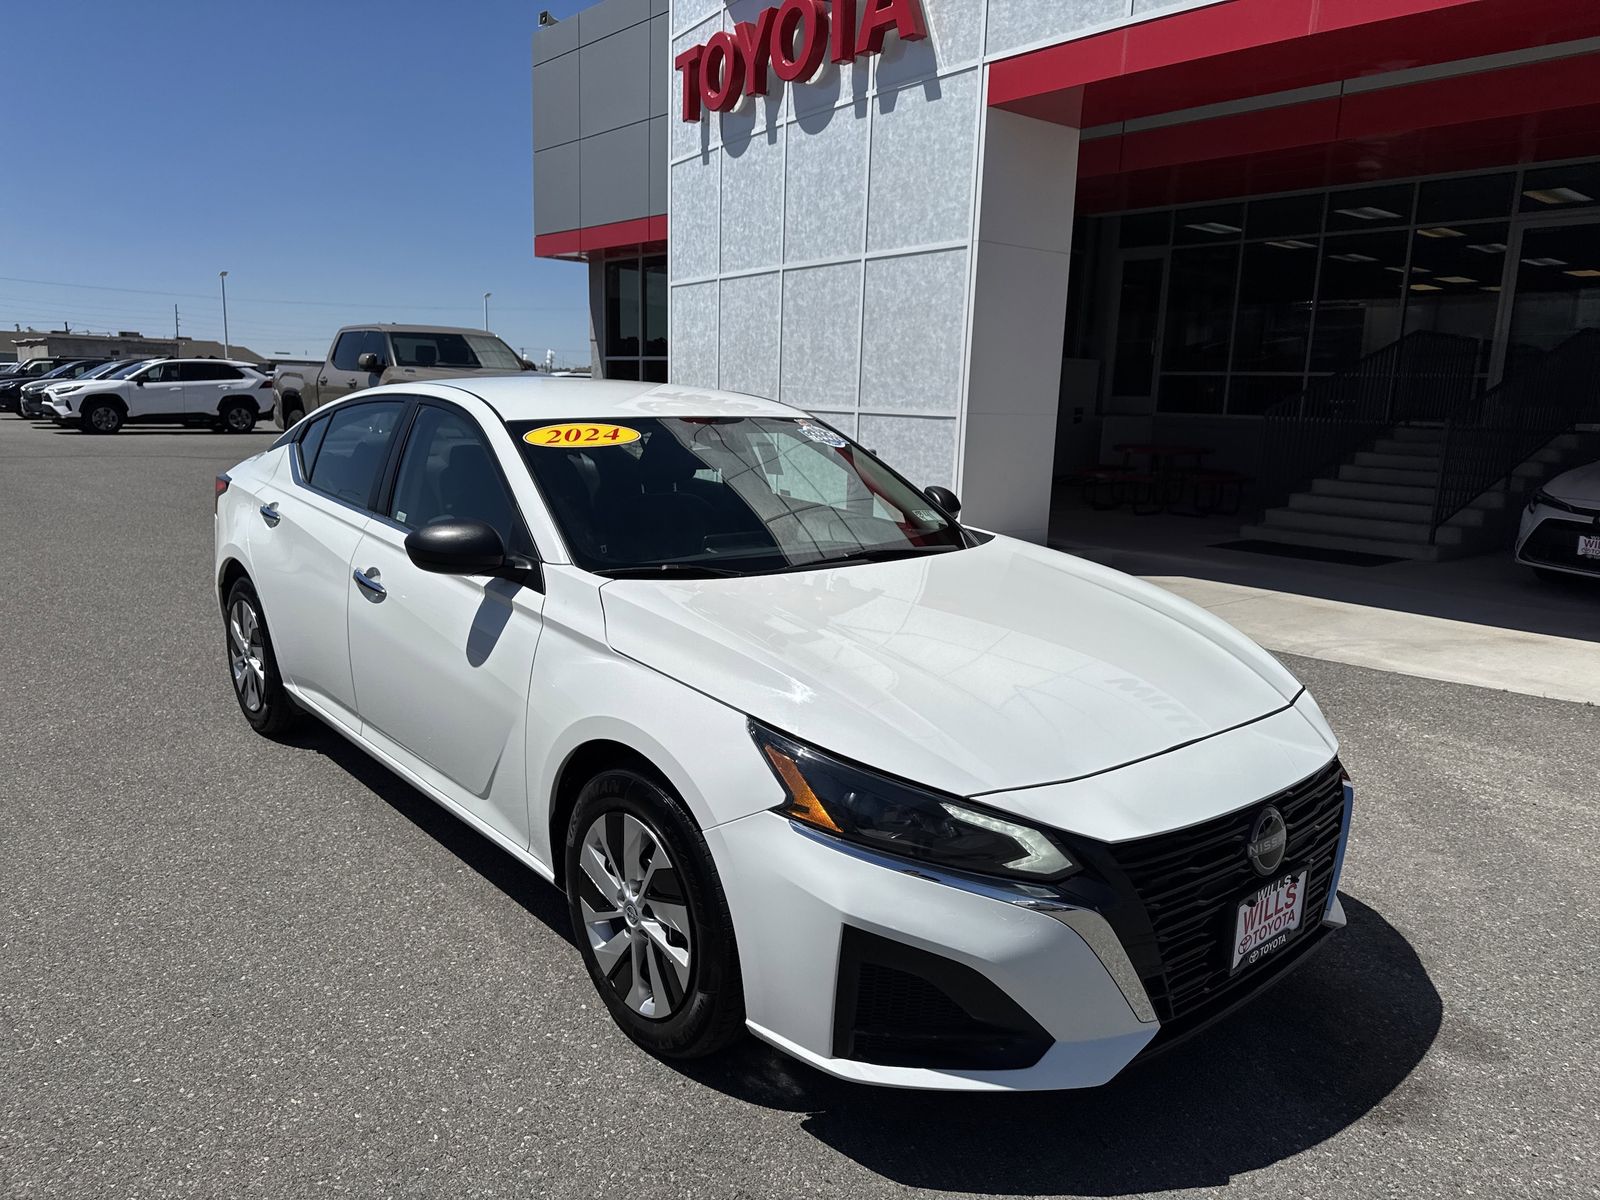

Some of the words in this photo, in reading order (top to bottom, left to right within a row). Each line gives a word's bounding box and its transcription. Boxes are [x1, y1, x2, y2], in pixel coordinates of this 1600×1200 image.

[546, 428, 620, 444] 2024
[1257, 875, 1292, 902] WILLS
[1244, 882, 1297, 935] WILLS
[1253, 909, 1295, 944] TOYOTA
[1260, 934, 1287, 956] TOYOTA
